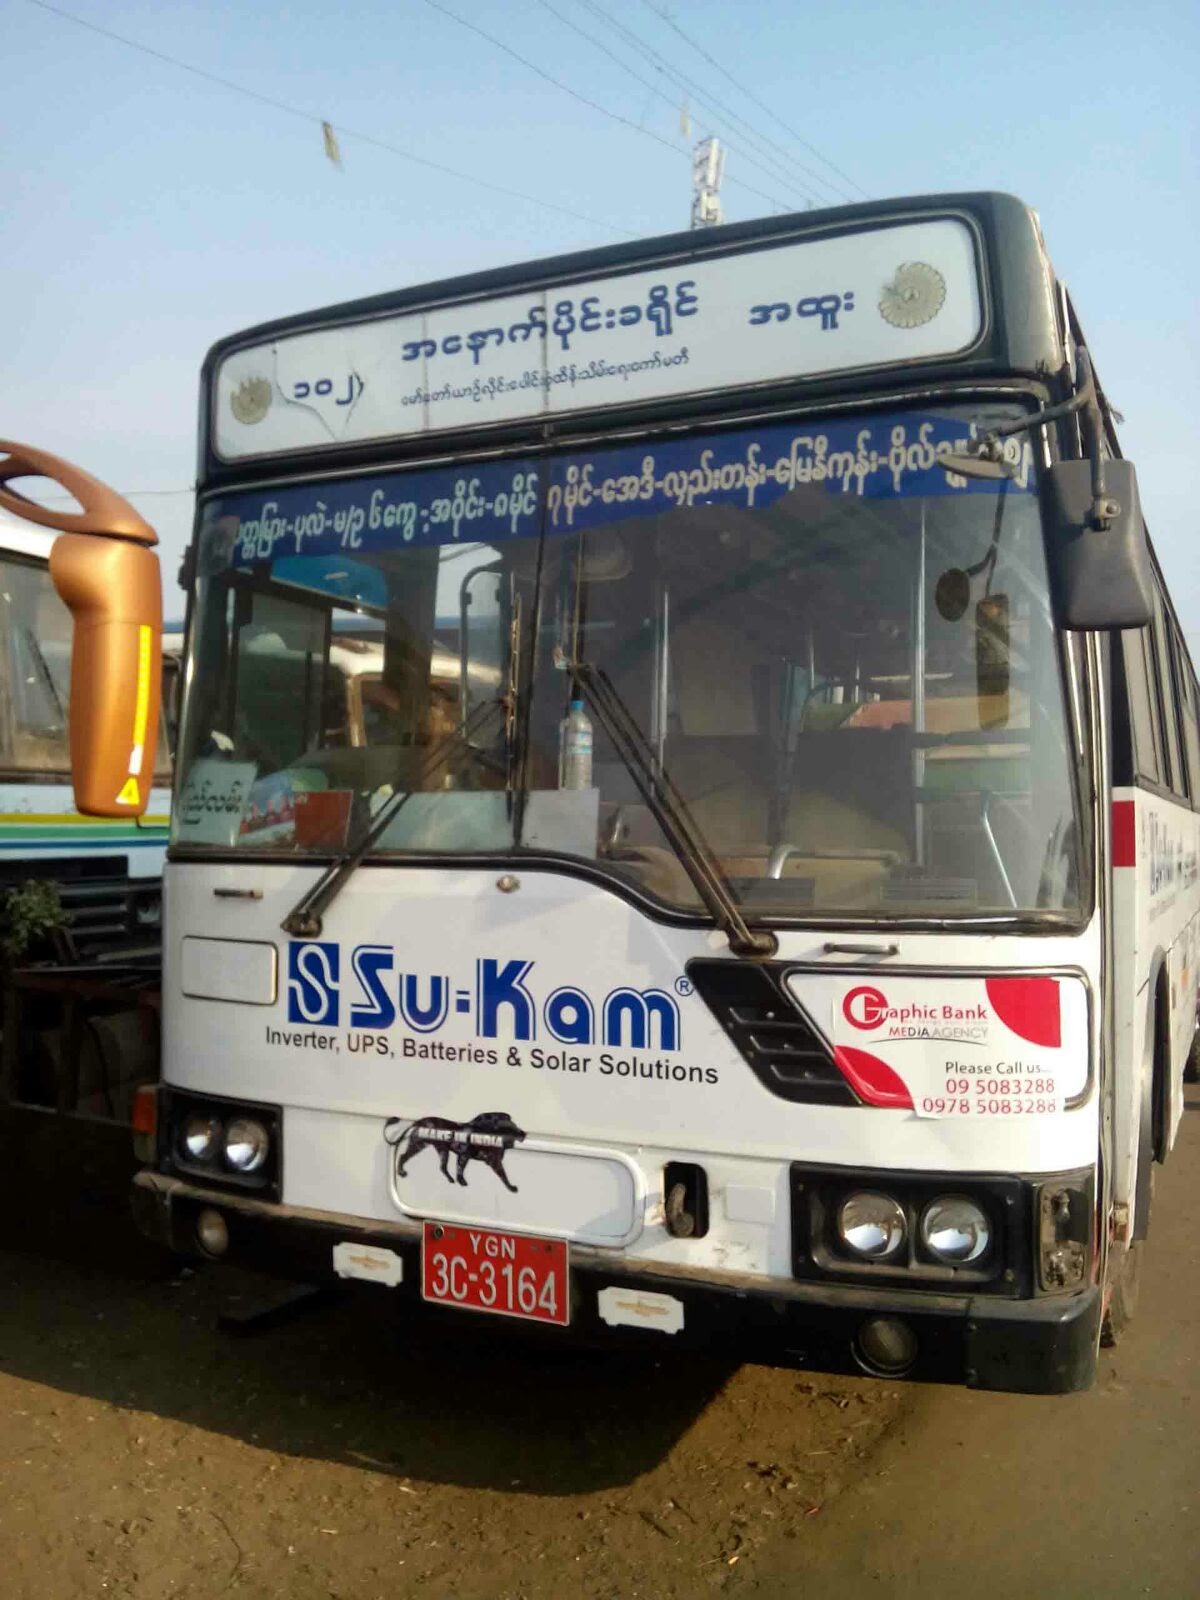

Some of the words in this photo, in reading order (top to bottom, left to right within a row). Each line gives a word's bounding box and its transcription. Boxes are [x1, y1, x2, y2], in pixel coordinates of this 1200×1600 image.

[749, 291, 854, 331] အထူး
[350, 944, 681, 1051] Su-Kam
[943, 1003, 988, 1020] Bank
[932, 1027, 989, 1038] AGENCY
[265, 1026, 341, 1054] Inverter,
[347, 1034, 396, 1059] UPS,
[402, 1038, 498, 1066] Batteries
[506, 1046, 522, 1068] &
[530, 1048, 591, 1073] Solar
[599, 1053, 719, 1084] Solutions
[945, 1061, 992, 1075] Please
[996, 1061, 1023, 1075] Call
[945, 1079, 970, 1095] 09
[976, 1078, 1055, 1095] 5083288
[922, 1098, 971, 1114] 0978
[977, 1098, 1056, 1114] 5083288
[469, 1234, 516, 1260] YGN
[431, 1252, 558, 1316] 3C-3164
